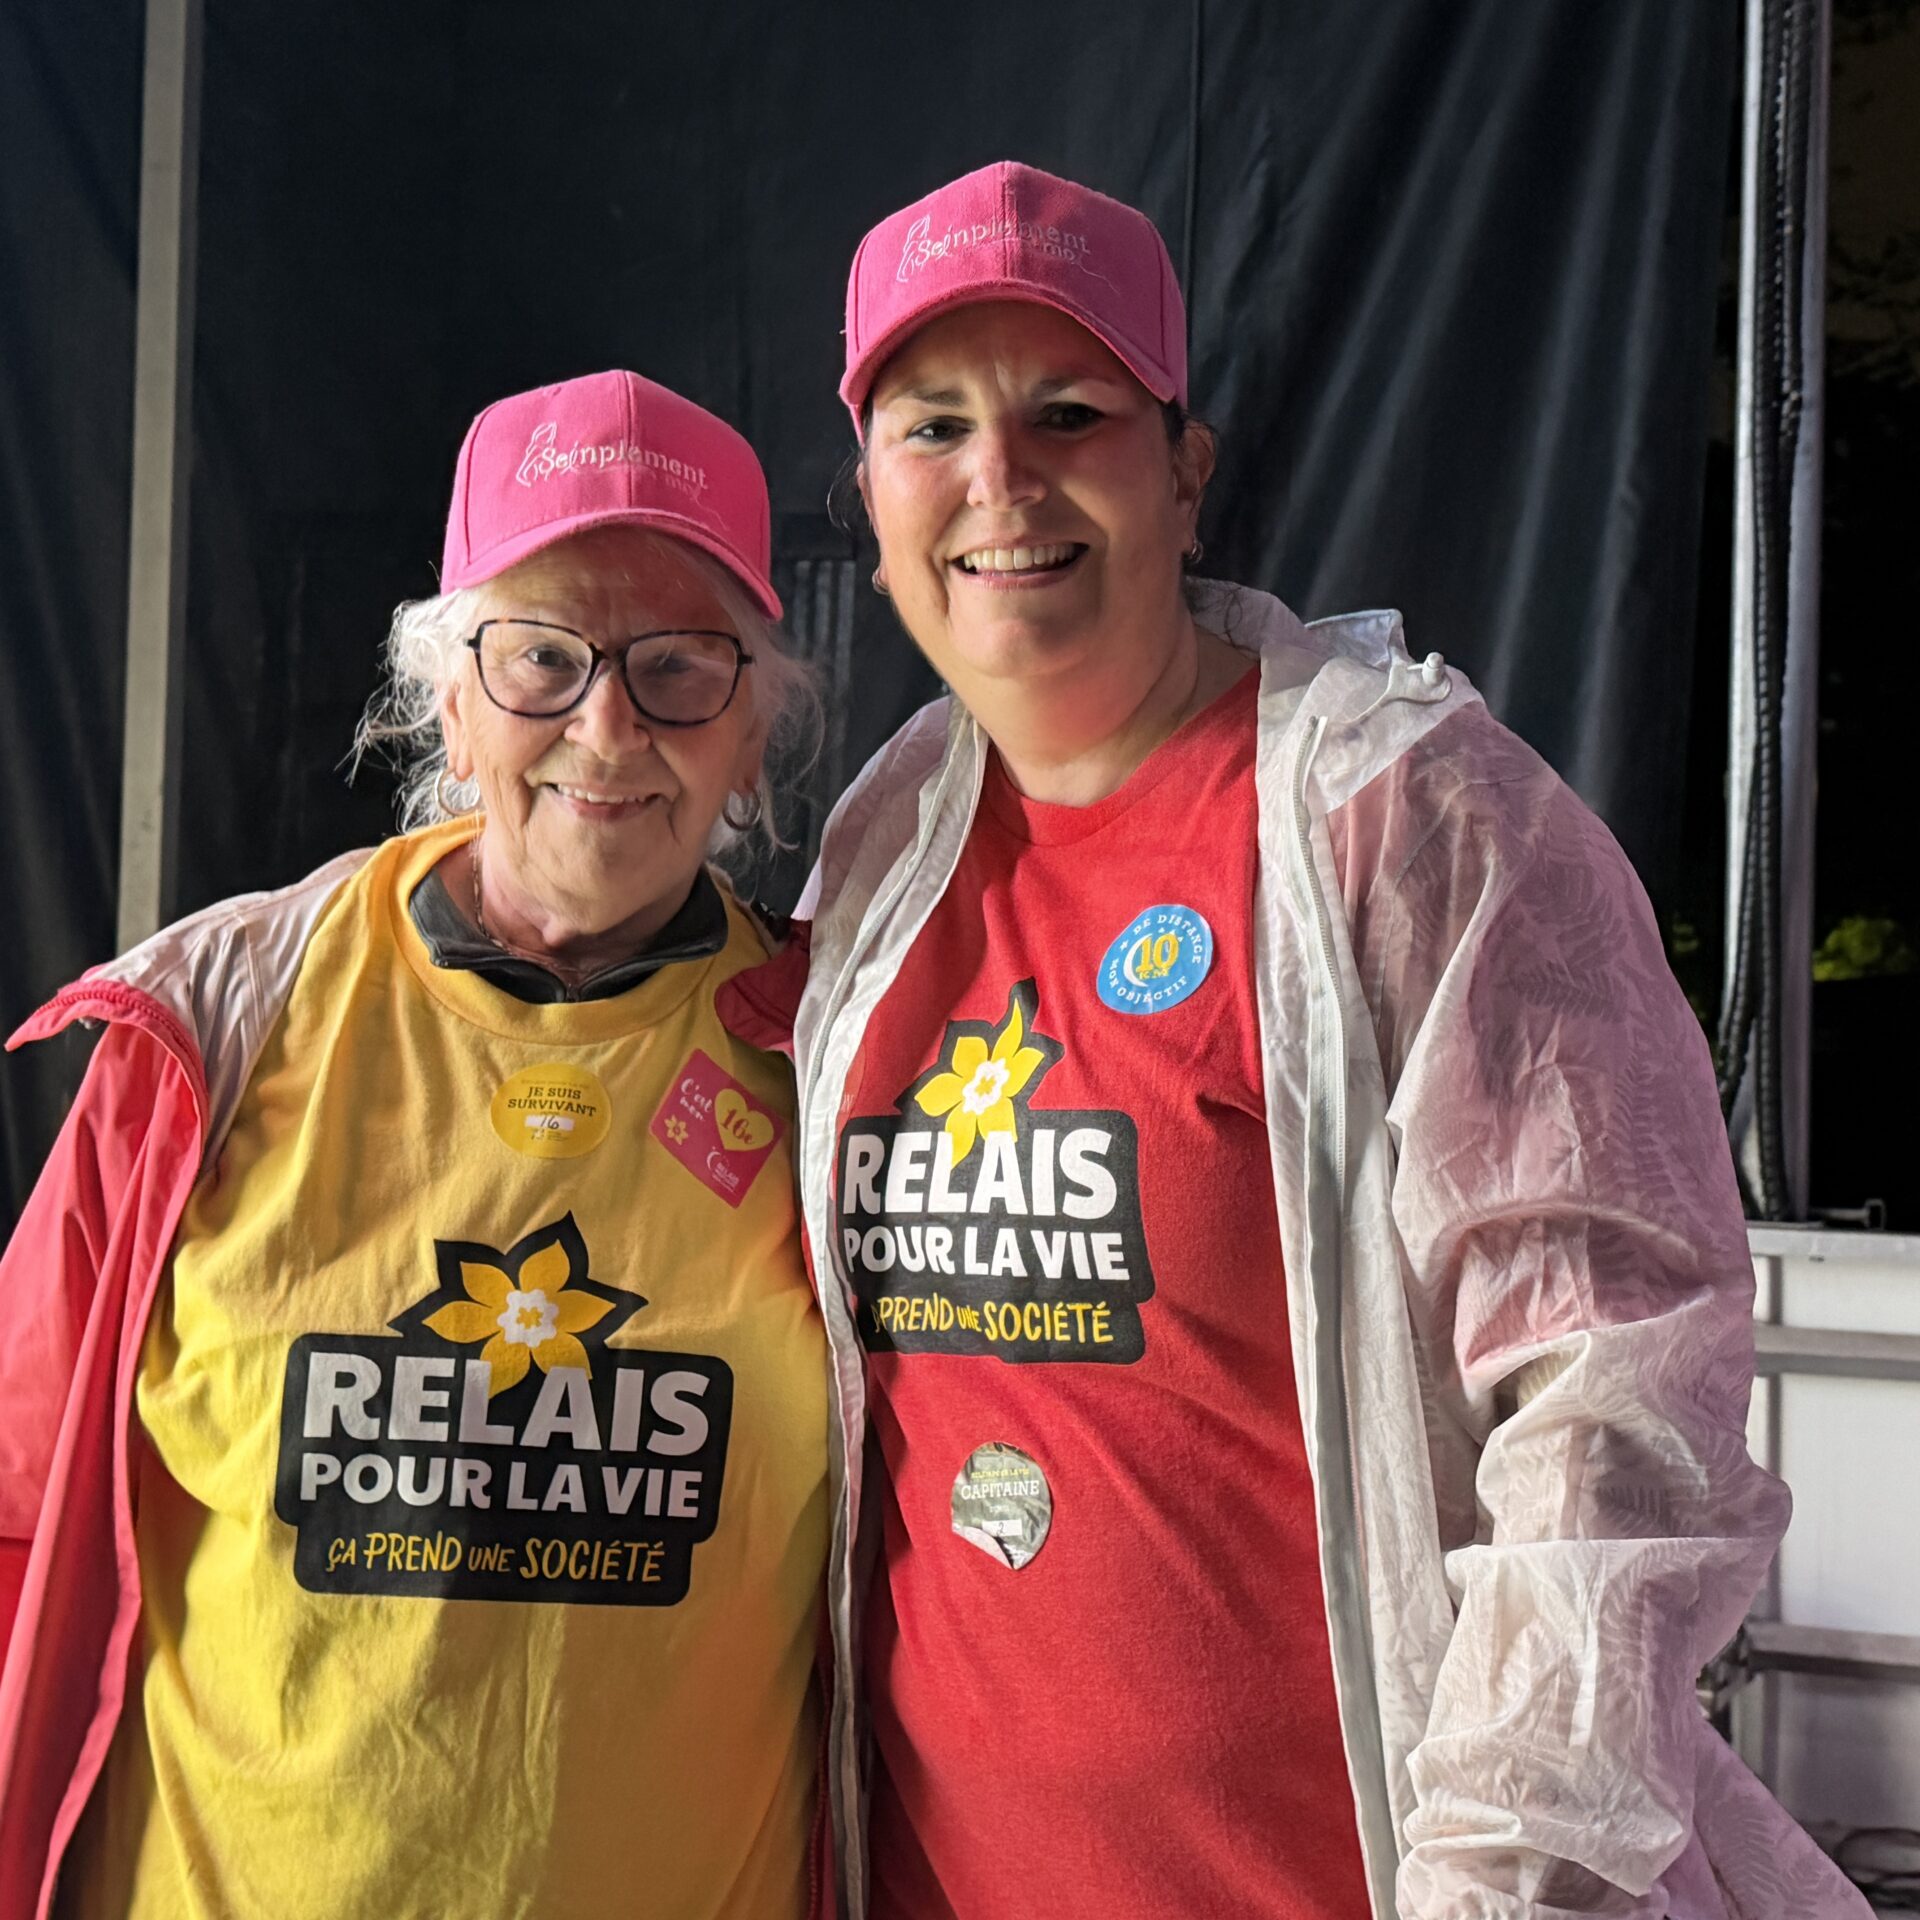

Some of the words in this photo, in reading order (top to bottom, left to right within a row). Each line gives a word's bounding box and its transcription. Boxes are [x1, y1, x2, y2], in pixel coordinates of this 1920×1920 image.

[1135, 932, 1179, 973] 10
[1157, 914, 1203, 964] DISTANCE
[1117, 975, 1188, 1004] OBJECTIF
[507, 1098, 596, 1117] SURVIVANT
[527, 1086, 544, 1099] JE
[547, 1087, 581, 1100] SUIS
[540, 1115, 560, 1130] 16
[842, 1128, 1117, 1219] RELAIS
[844, 1226, 955, 1275] POUR
[964, 1227, 1028, 1277] LA
[1030, 1230, 1130, 1280] VIE
[877, 1291, 954, 1333] PREND
[956, 1305, 983, 1332] UNE
[983, 1300, 1113, 1343] SOCIÉTÉ
[303, 1351, 711, 1456] RELAIS
[300, 1452, 493, 1509] POUR
[506, 1461, 588, 1513] LA
[602, 1466, 703, 1518] VIE
[960, 1480, 1040, 1500] CAPITAINE
[325, 1538, 356, 1572] ÇA
[363, 1530, 463, 1572] PREND
[468, 1543, 516, 1572] UNE
[519, 1537, 666, 1582] SOCIÉTÉ
